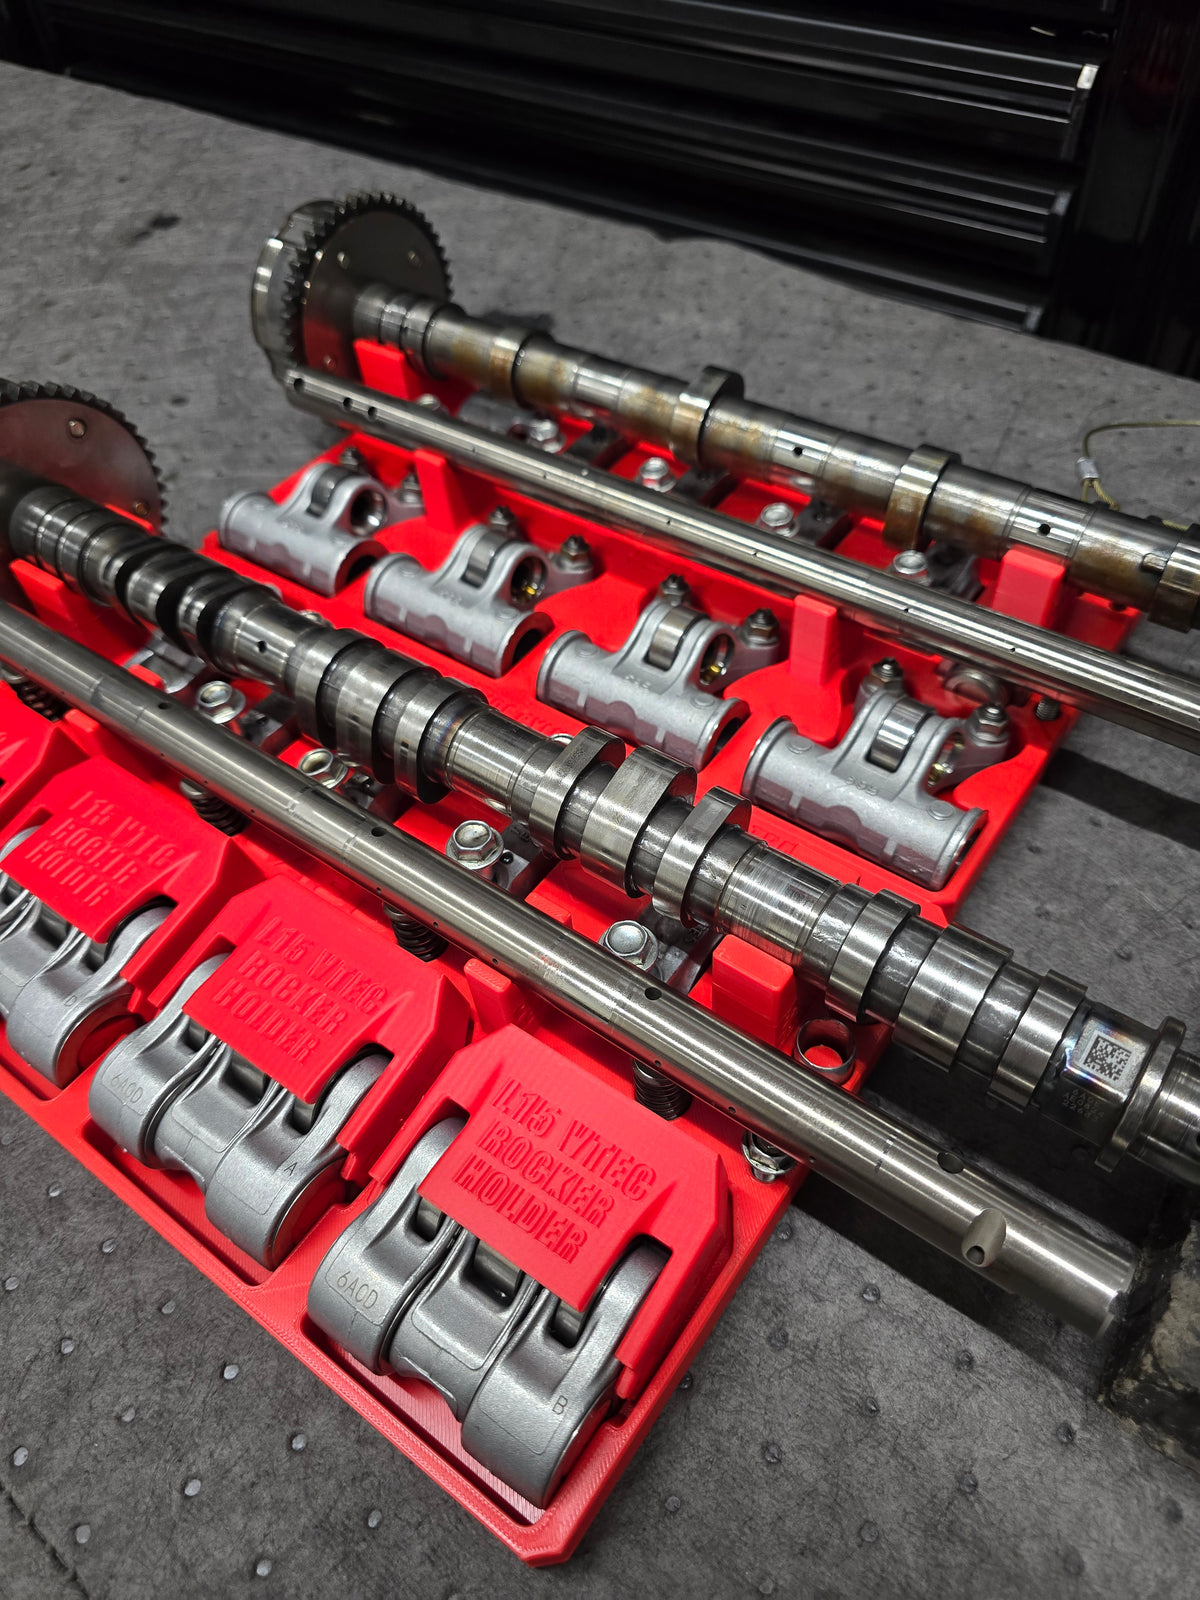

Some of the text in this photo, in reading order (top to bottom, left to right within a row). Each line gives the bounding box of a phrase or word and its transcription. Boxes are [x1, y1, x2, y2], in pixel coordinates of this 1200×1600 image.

[238, 950, 348, 1034] ROCKER
[254, 916, 388, 1015] L15 VTEC
[213, 977, 320, 1064] HOLDER
[283, 1161, 298, 1177] A
[476, 1119, 615, 1228] ROCKER
[492, 1077, 657, 1201] L15 VTEC
[452, 1152, 588, 1264] HOLDER
[551, 1394, 568, 1416] B
